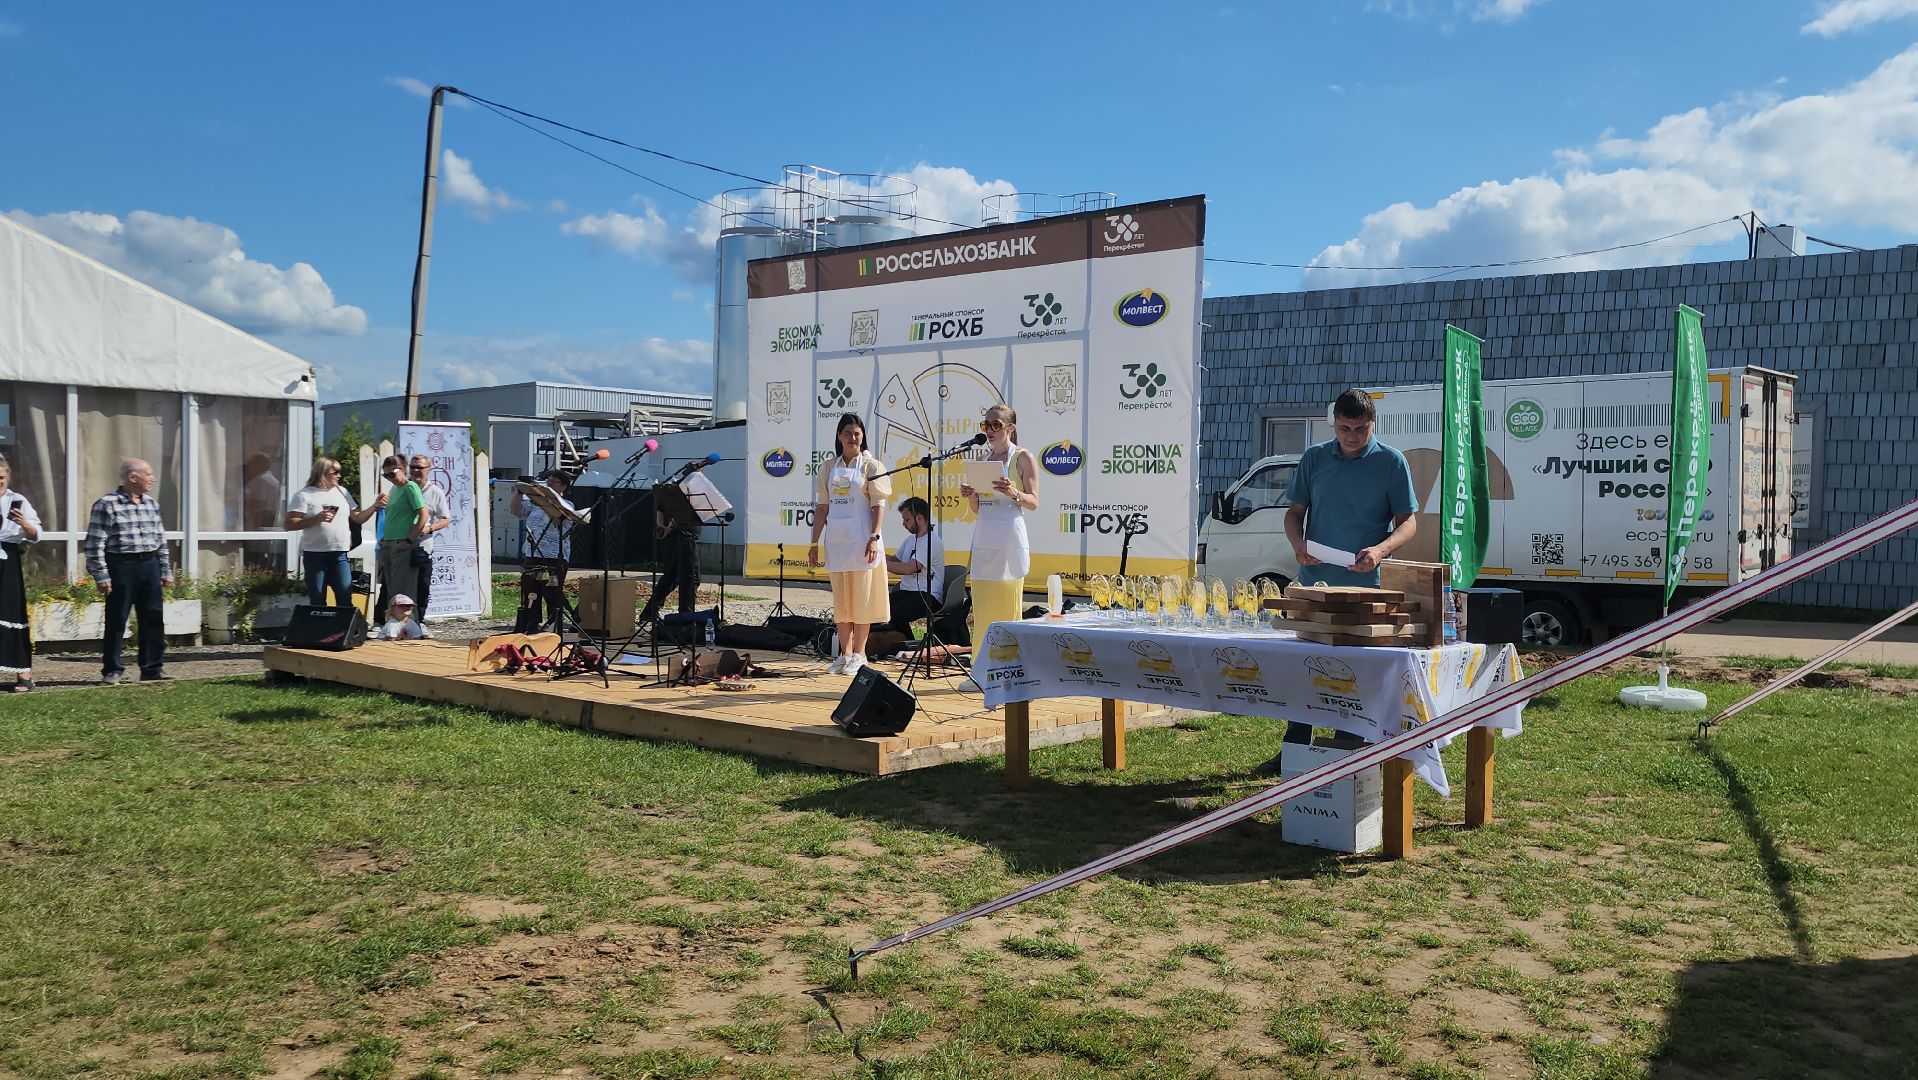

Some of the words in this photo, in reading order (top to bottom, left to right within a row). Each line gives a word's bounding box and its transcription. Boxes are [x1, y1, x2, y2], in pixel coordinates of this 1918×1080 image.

[1103, 242, 1145, 252] Перекрёсток
[876, 235, 1037, 274] РОССЕЛЬХОЗБАНК
[911, 311, 954, 321] ГЕНЕРАЛЬНЫЙ
[954, 308, 985, 317] СПОНСОР
[1122, 304, 1164, 316] МОЛВЕСТ
[1054, 317, 1068, 326] ЛЕТ
[778, 324, 823, 340] EKONIVA
[929, 317, 984, 340] РСХБ
[1018, 328, 1067, 340] Перекрёсток
[770, 337, 818, 353] ЭКОНИВА
[1159, 389, 1173, 398] ЛЕТ
[1118, 401, 1173, 411] Перекрёсток
[1510, 411, 1540, 426] eco
[1511, 425, 1539, 433] VILLAGE
[1451, 347, 1469, 536] Перекрёсток
[1576, 433, 1647, 452] Здесь
[1112, 444, 1182, 459] EKONIVA
[766, 460, 793, 468] МОЛВЕСТ
[1045, 456, 1080, 465] МОЛВЕСТ
[1532, 454, 1648, 479] «Лучший
[1101, 460, 1177, 474] ЭКОНИВА
[934, 496, 960, 508] 2025
[1060, 503, 1111, 511] ГЕНЕРАЛЬНЫЙ
[1112, 504, 1149, 512] СПОНСОР
[1080, 513, 1149, 535] РСХБ
[1580, 554, 1597, 567] +7
[1602, 554, 1629, 567] 495
[1634, 556, 1662, 569] 369
[1694, 557, 1713, 570] 58
[996, 669, 1025, 681] РСХБ
[1077, 669, 1104, 678] РСХБ
[1154, 677, 1183, 687] РСХБ
[1238, 686, 1269, 696] РСХБ
[1331, 698, 1363, 711] РСХБ
[1293, 804, 1339, 819] ANIMA
